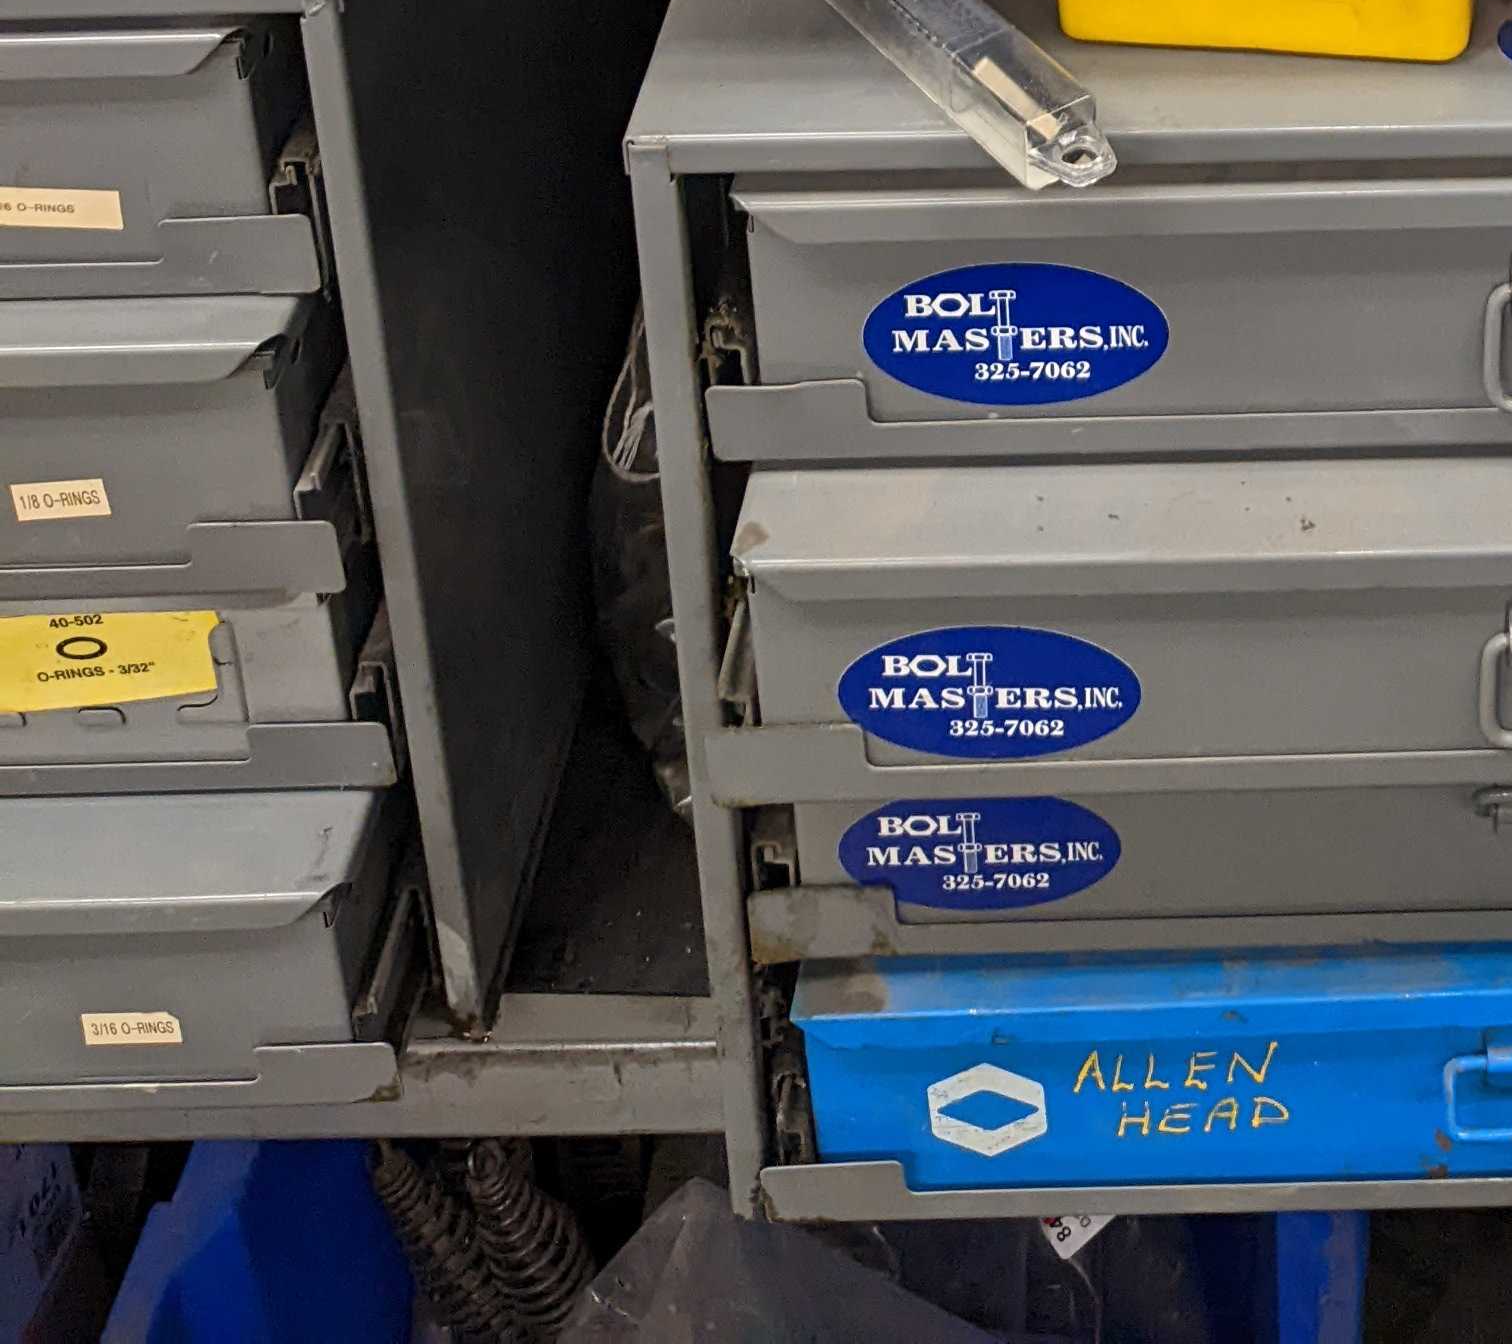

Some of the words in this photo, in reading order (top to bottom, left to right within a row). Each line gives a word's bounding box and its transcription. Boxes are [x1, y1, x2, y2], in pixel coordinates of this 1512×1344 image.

[17, 202, 75, 214] O-RINGS
[974, 361, 1091, 381] 325-7062
[20, 494, 41, 511] 1/8
[43, 489, 101, 509] O-RINGS
[49, 614, 105, 630] 40-502
[37, 665, 106, 683] O-RINGS
[118, 661, 156, 676] 3/32"
[949, 719, 1065, 737] 325-7062
[942, 873, 1050, 890] 325-7062
[90, 1022, 118, 1036] 3/16
[120, 1021, 175, 1035] O-RINGS
[1072, 1040, 1279, 1094] ALLEN
[1116, 1096, 1291, 1138] HEAD
